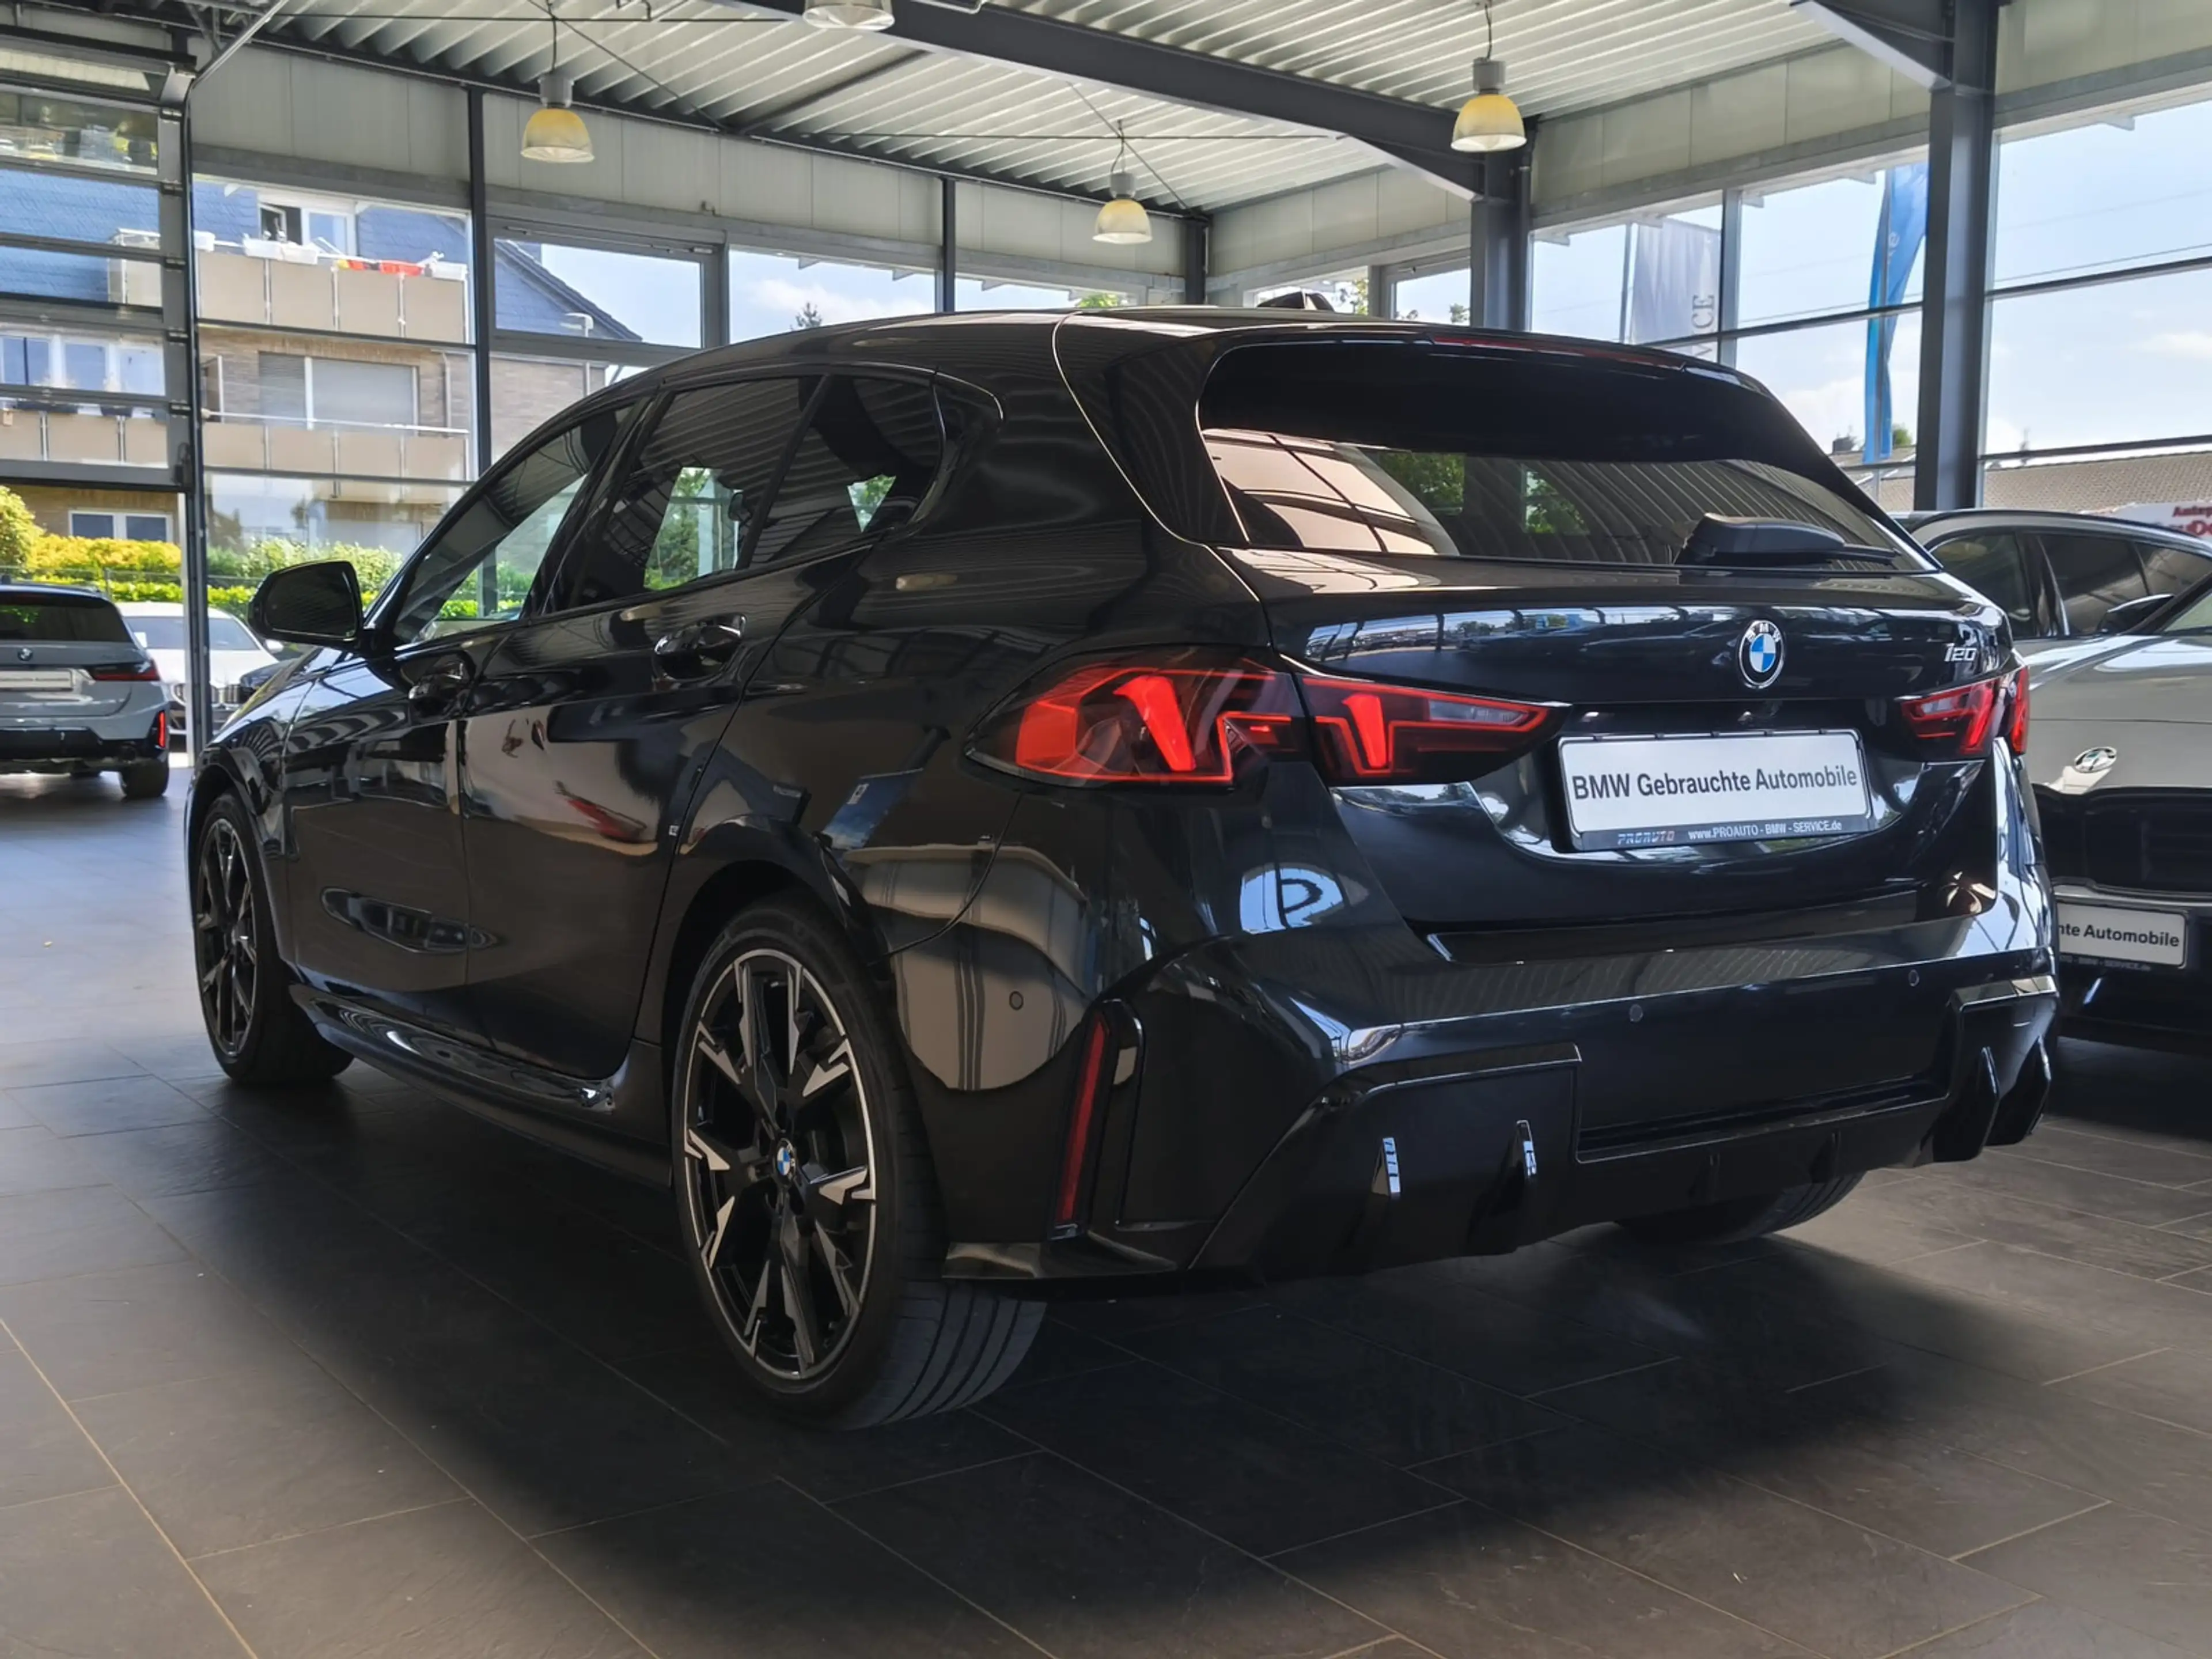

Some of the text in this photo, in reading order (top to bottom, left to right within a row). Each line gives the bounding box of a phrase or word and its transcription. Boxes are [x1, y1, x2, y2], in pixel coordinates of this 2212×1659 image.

[1944, 642, 1978, 662] 120
[1573, 765, 1857, 800] BMW Gebrauchte Automobile
[1618, 831, 1675, 846] PROAUTO
[2084, 925, 2179, 946] Automobile
